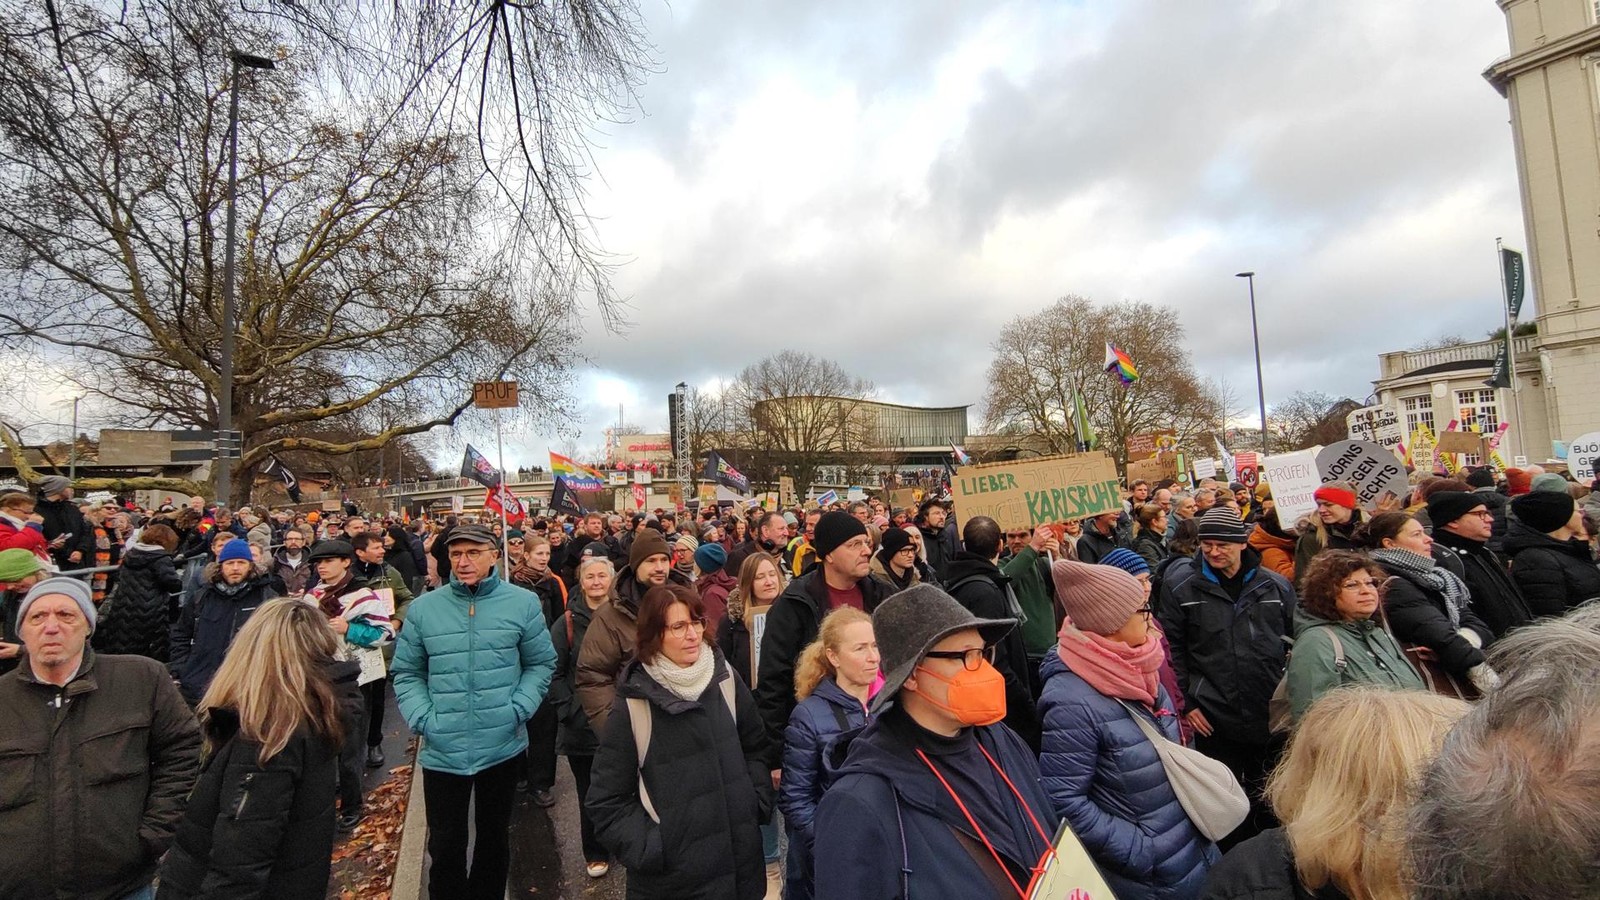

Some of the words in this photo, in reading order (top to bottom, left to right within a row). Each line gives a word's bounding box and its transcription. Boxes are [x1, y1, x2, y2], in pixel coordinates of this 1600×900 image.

[1573, 442, 1600, 453] BJÖ
[1579, 457, 1595, 466] GE
[960, 473, 1019, 496] LIEBER
[1023, 460, 1101, 490] JETZT
[1347, 456, 1379, 487] GEN
[1577, 469, 1594, 478] RE
[1024, 480, 1123, 526] KARLSRUHE
[1277, 493, 1313, 508] DEMOKRAT
